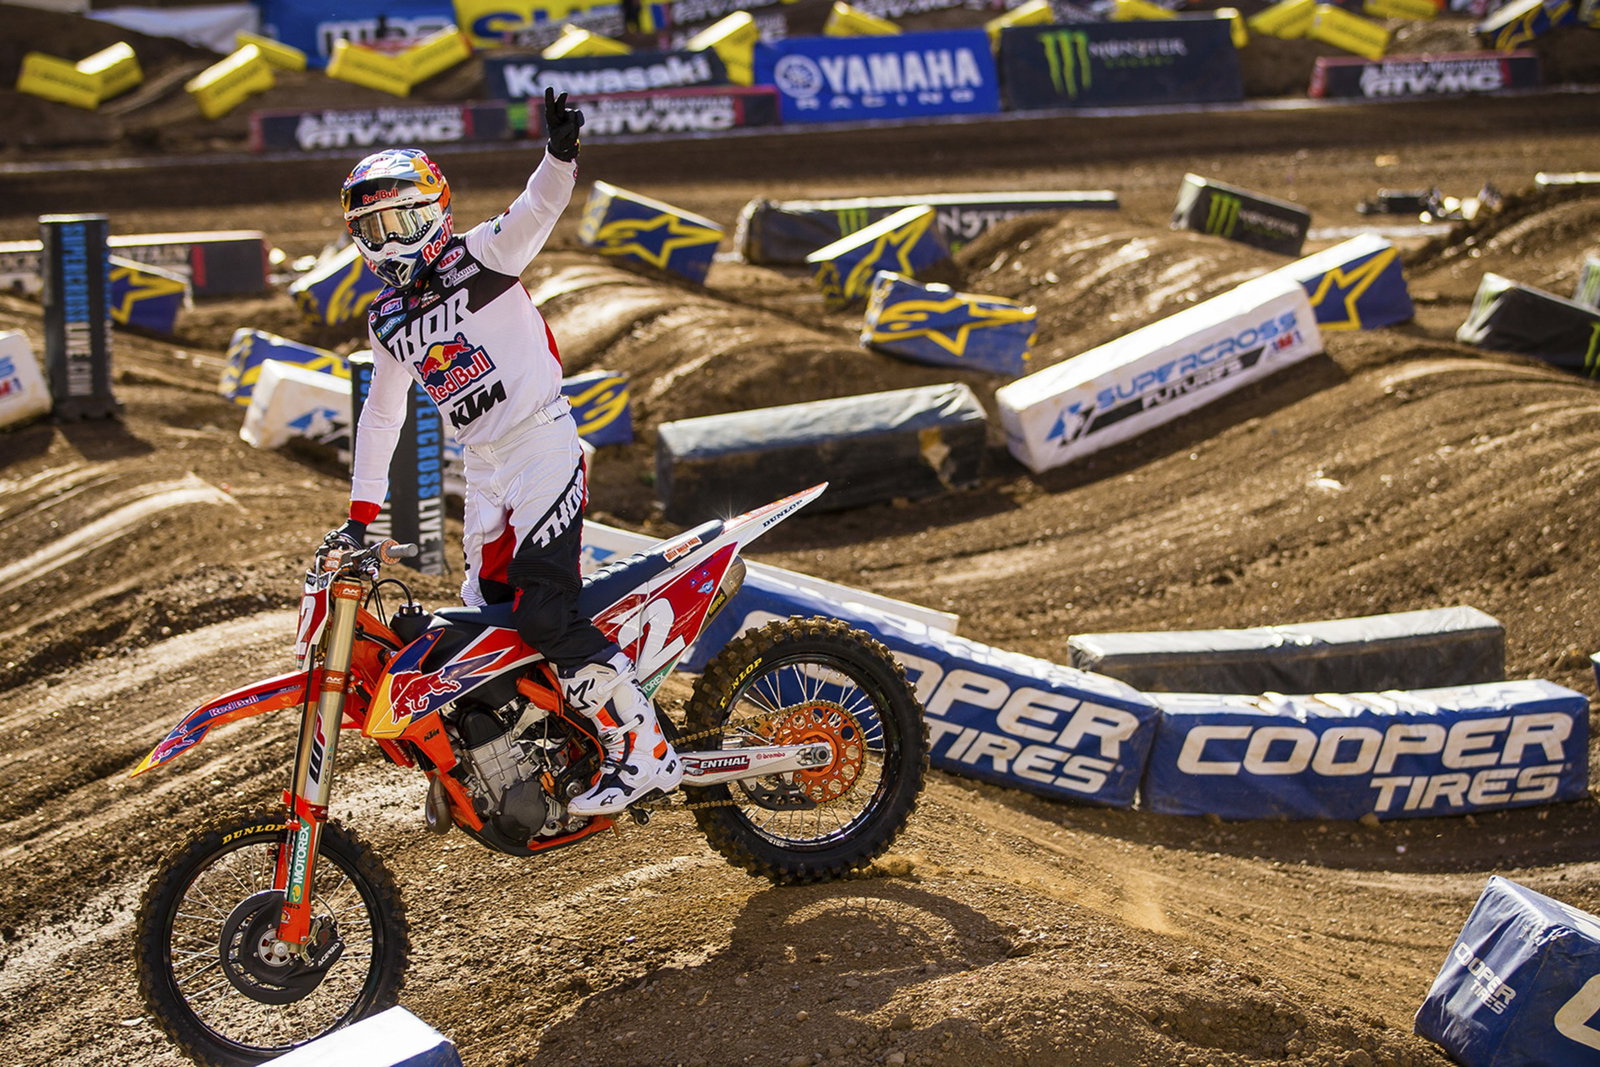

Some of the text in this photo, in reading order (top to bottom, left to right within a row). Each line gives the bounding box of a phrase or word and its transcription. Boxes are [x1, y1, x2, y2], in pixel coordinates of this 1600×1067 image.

[503, 55, 712, 98] Kawasaki
[818, 48, 982, 94] YAMAHA
[796, 88, 975, 110] RACING
[362, 187, 399, 206] Red Bull
[421, 220, 448, 266] Red
[438, 250, 461, 269] BELL
[387, 287, 470, 363] THOR
[426, 350, 492, 403] Red Bull
[449, 380, 507, 430] KTM
[762, 499, 803, 528] DUNLOP
[617, 597, 686, 684] 2
[641, 672, 666, 693] TOREX
[927, 718, 1118, 795] TIRES
[1177, 711, 1574, 777] COOPER
[1370, 764, 1565, 812] TIRES
[221, 823, 288, 845] DUNLOP
[292, 825, 310, 884] MOTOREX
[1453, 941, 1517, 1006] COOPER
[1470, 978, 1508, 1015] TIRES
